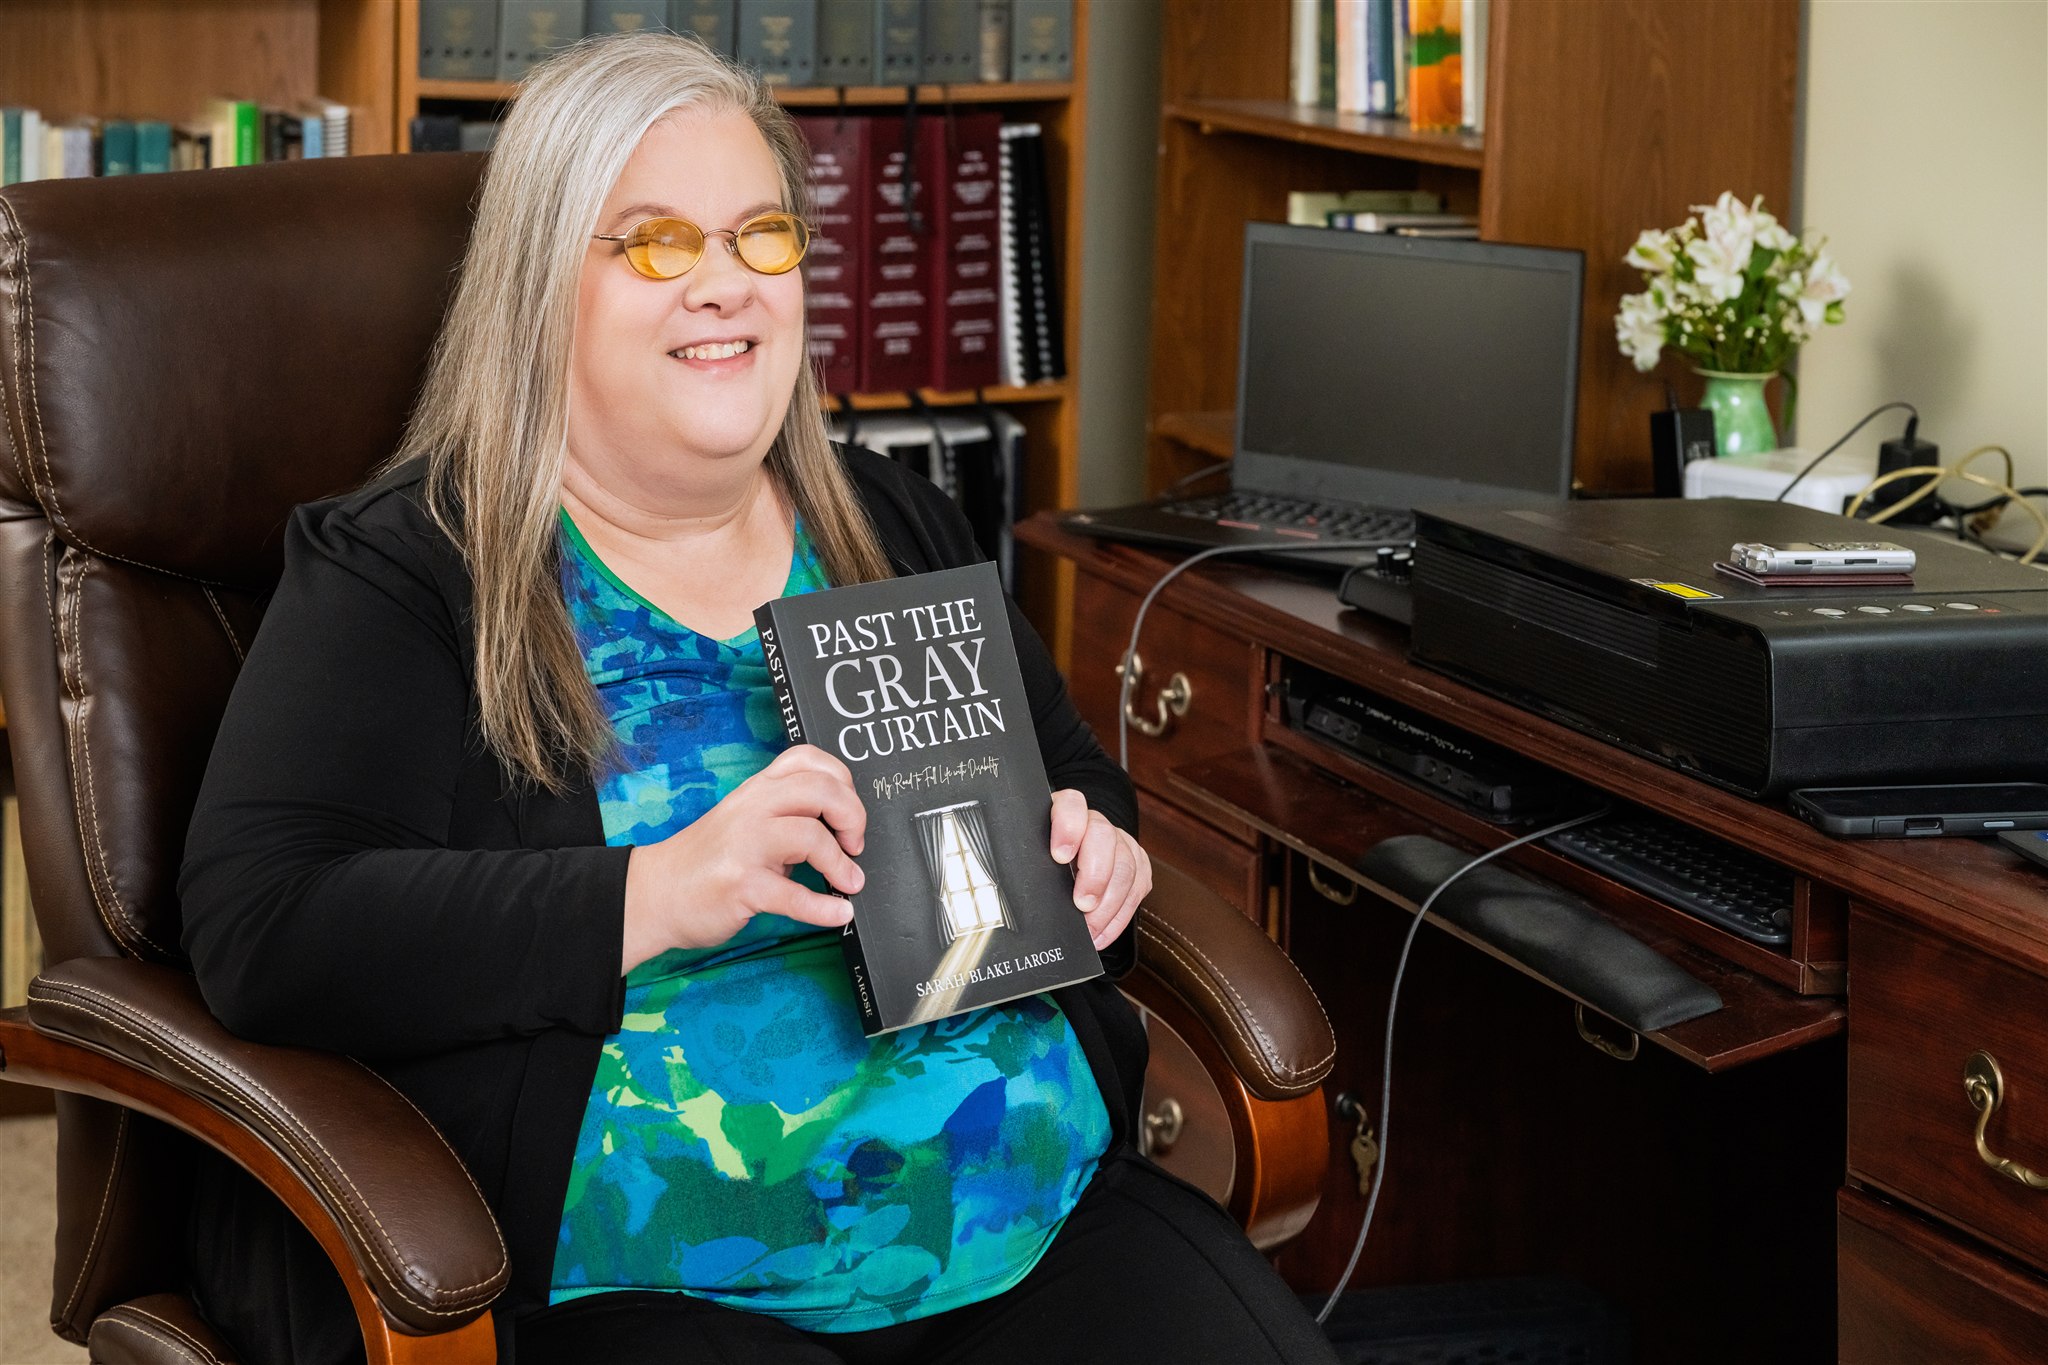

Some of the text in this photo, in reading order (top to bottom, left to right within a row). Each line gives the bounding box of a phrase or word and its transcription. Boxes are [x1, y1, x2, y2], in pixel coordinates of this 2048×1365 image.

[808, 598, 982, 659] PAST THE
[762, 627, 801, 742] PAST THE
[824, 637, 989, 719] GRAY
[838, 698, 1006, 762] CURTAIN
[873, 756, 999, 800] My Road to Full Life with Disability
[854, 965, 873, 1018] LAROSE
[916, 947, 1065, 997] SARAH BLAKE LAROSE
